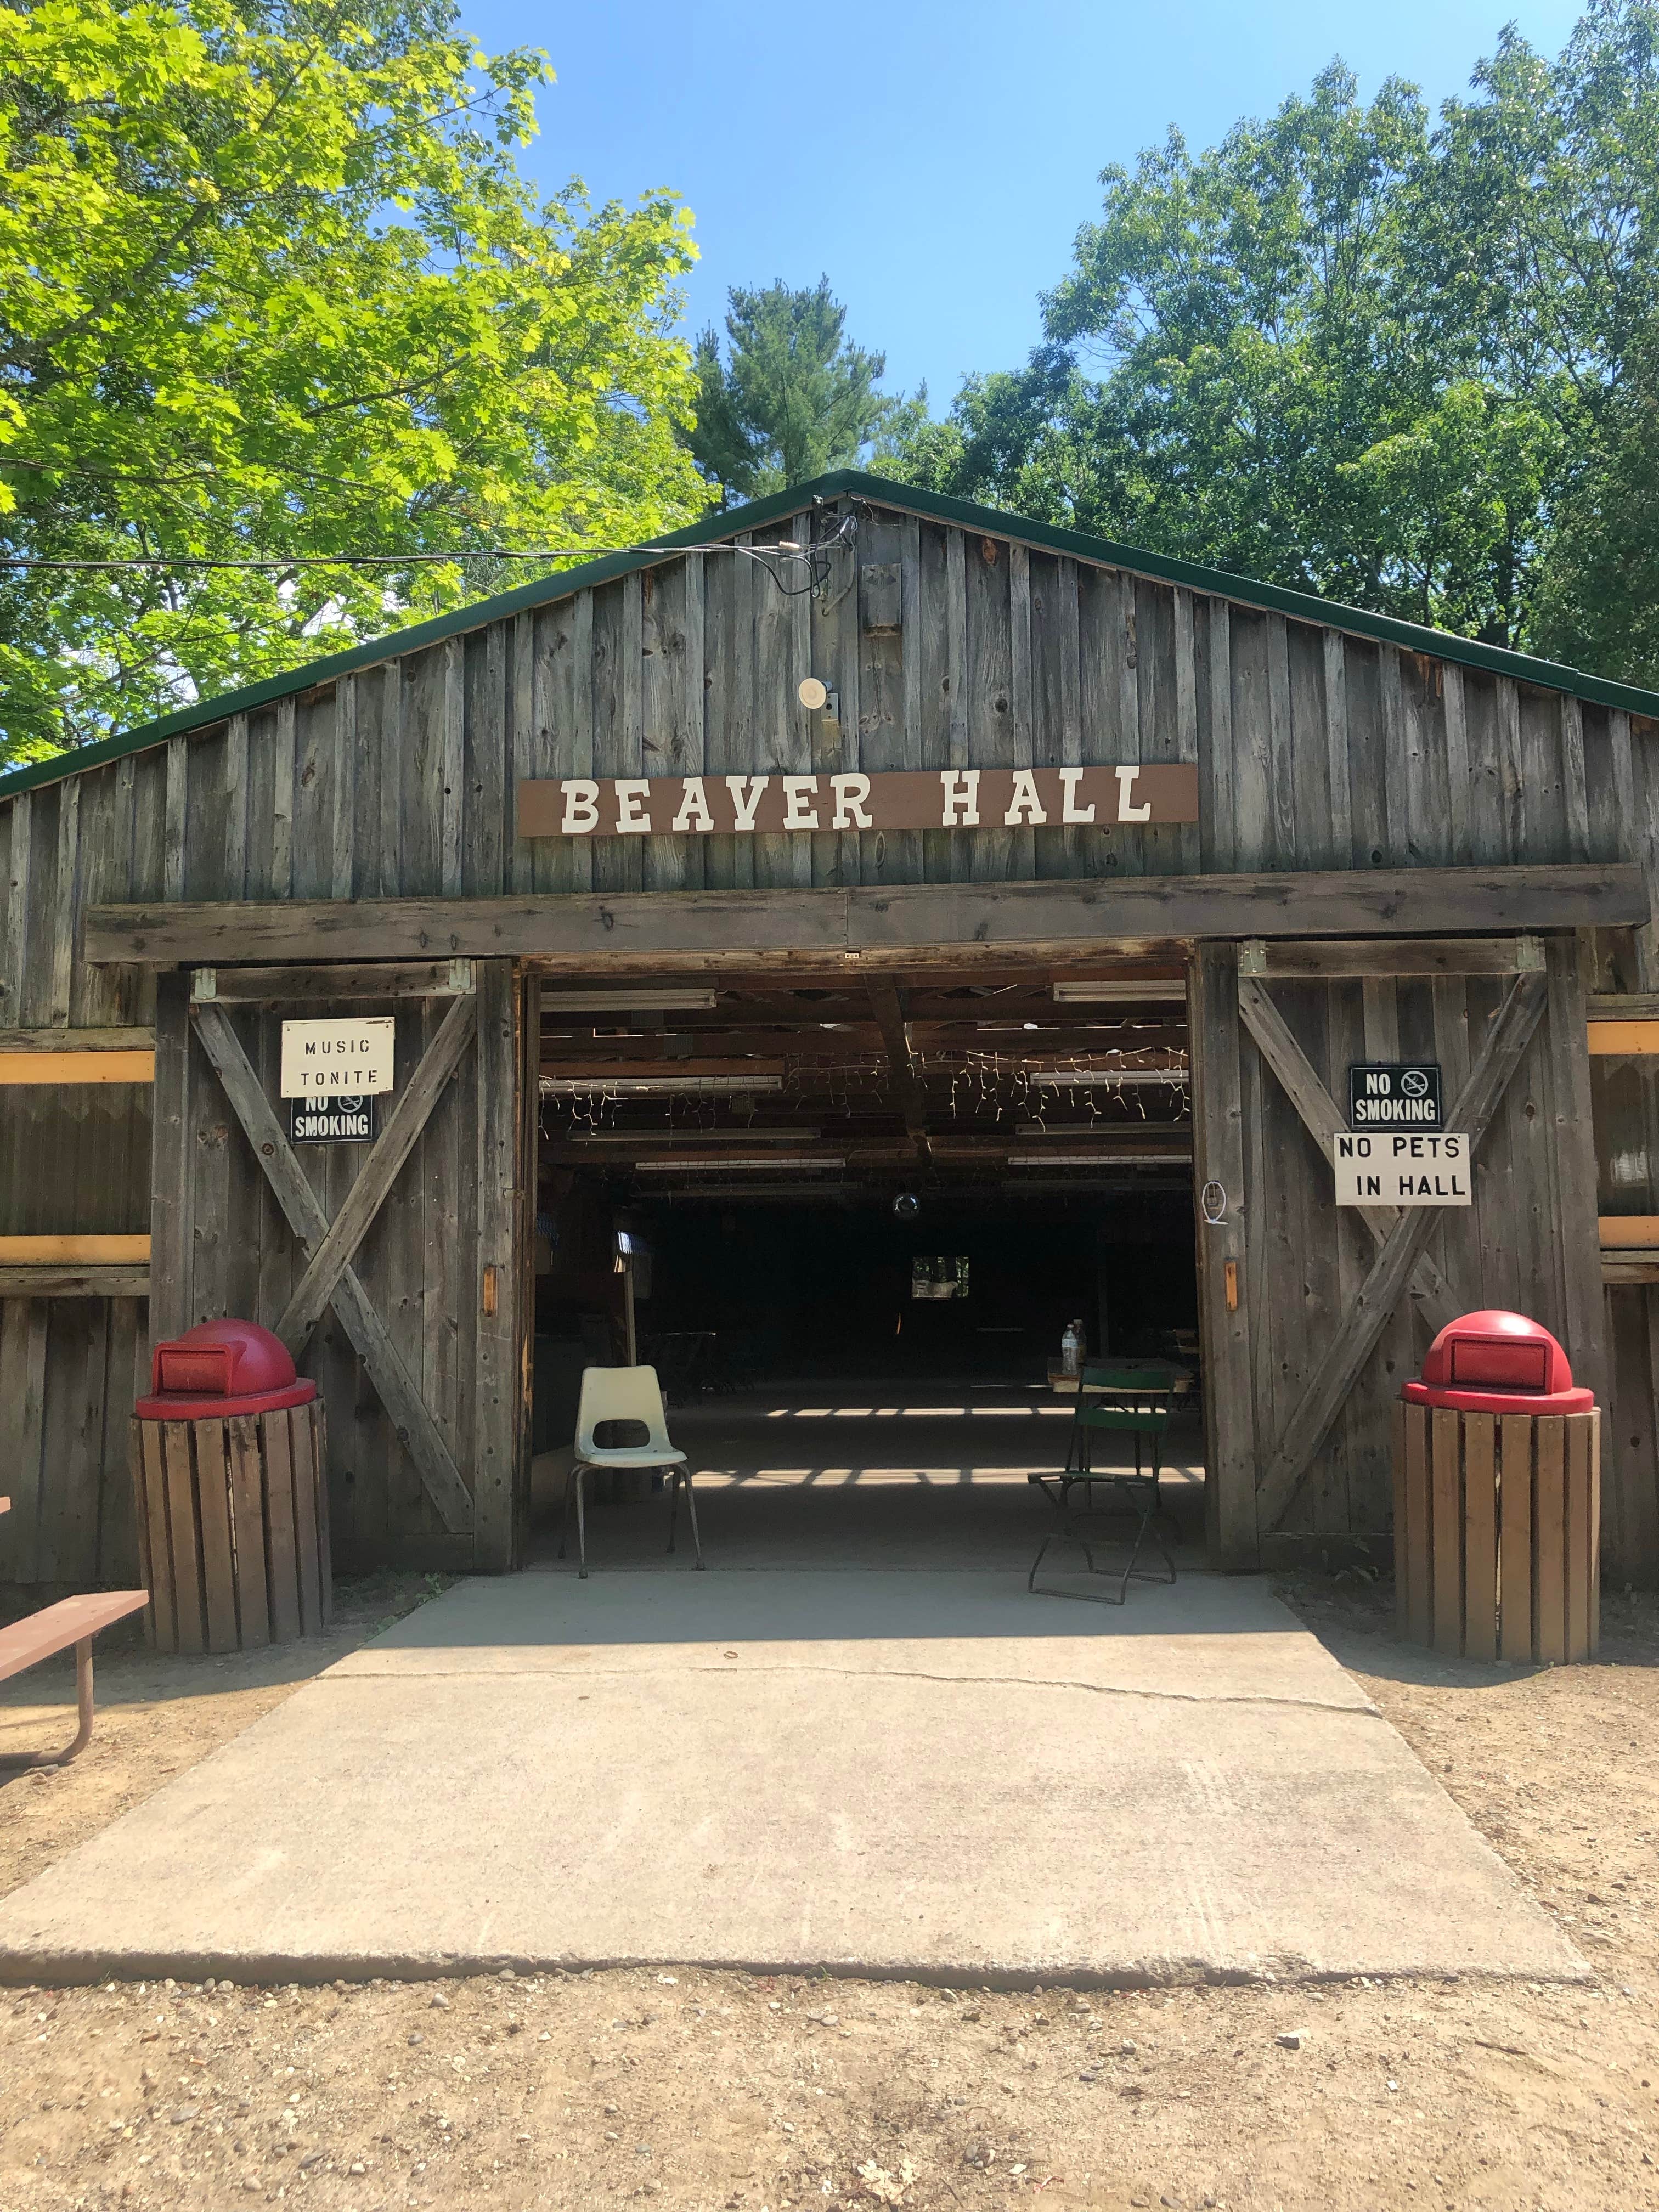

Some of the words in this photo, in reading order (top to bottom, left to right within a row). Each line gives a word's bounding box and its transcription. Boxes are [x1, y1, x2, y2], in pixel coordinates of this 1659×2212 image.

[561, 772, 873, 834] BEAVER
[941, 765, 1151, 826] HALL
[306, 1040, 369, 1055] MUSIC
[301, 1070, 377, 1085] TONITE
[1366, 1074, 1391, 1094] NO
[306, 1096, 328, 1111] NO
[1356, 1099, 1435, 1120] SMOKING
[295, 1114, 368, 1137] SMOKING
[1339, 1137, 1371, 1158] NO
[1393, 1137, 1459, 1158] PETS
[1357, 1176, 1380, 1195] IN
[1399, 1175, 1465, 1195] HALL
